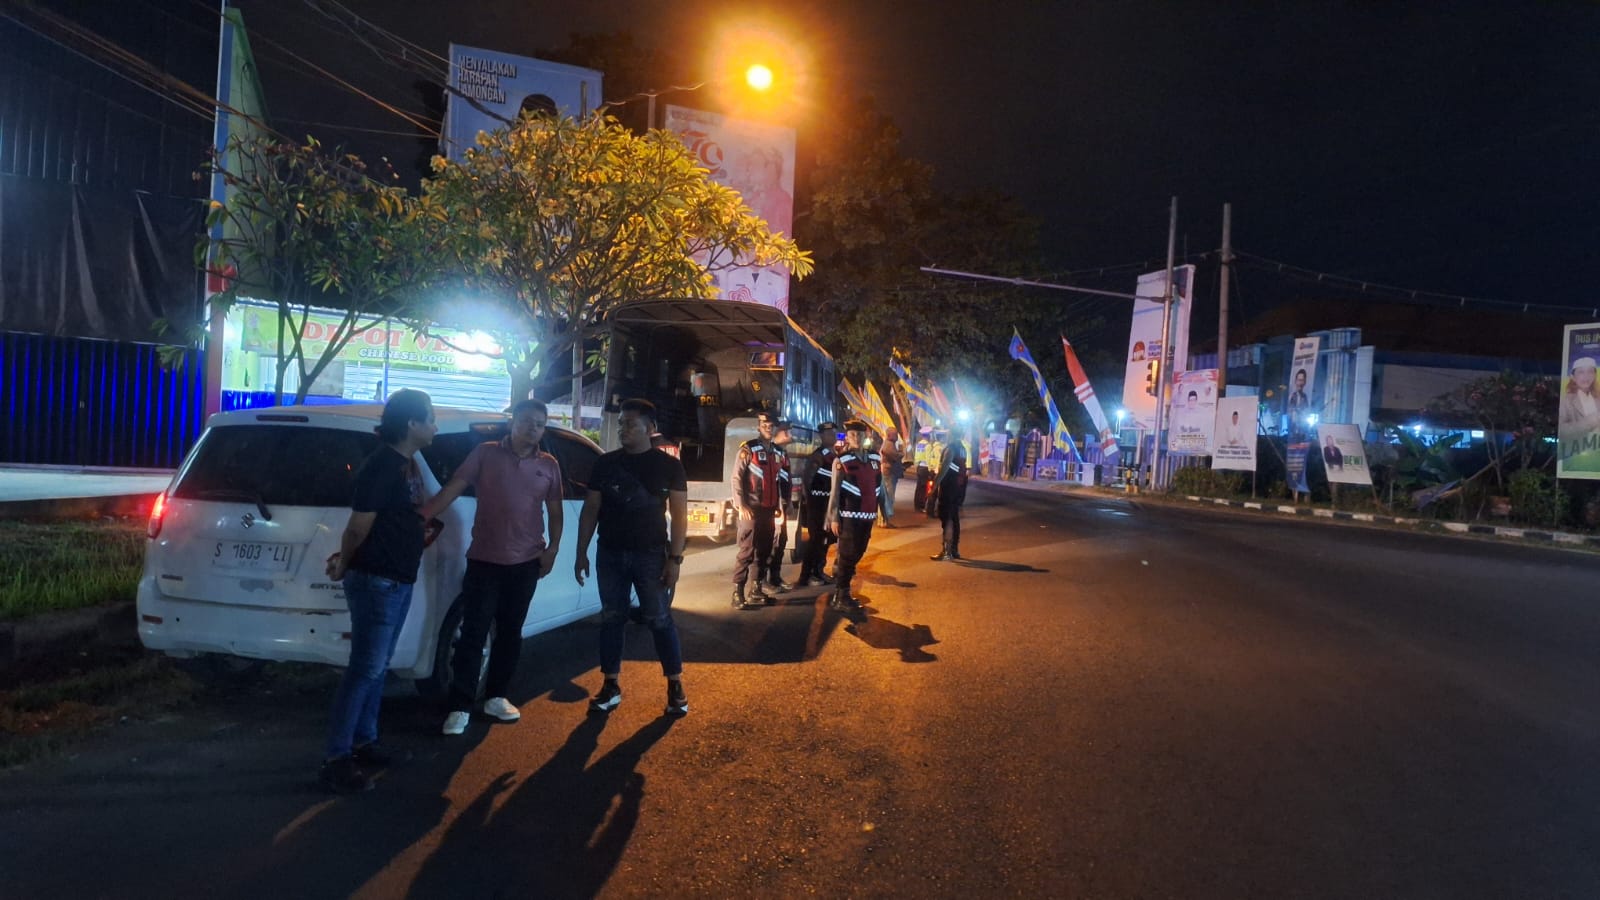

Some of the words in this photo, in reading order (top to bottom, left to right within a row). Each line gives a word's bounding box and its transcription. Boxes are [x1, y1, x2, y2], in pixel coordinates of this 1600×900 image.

[458, 55, 517, 78] MENYALAKAN
[457, 68, 499, 89] HARAPAN
[358, 348, 418, 362] CHINESE
[420, 352, 455, 365] FOOD
[215, 542, 223, 558] S
[233, 543, 262, 561] 1603
[273, 545, 288, 562] LI
